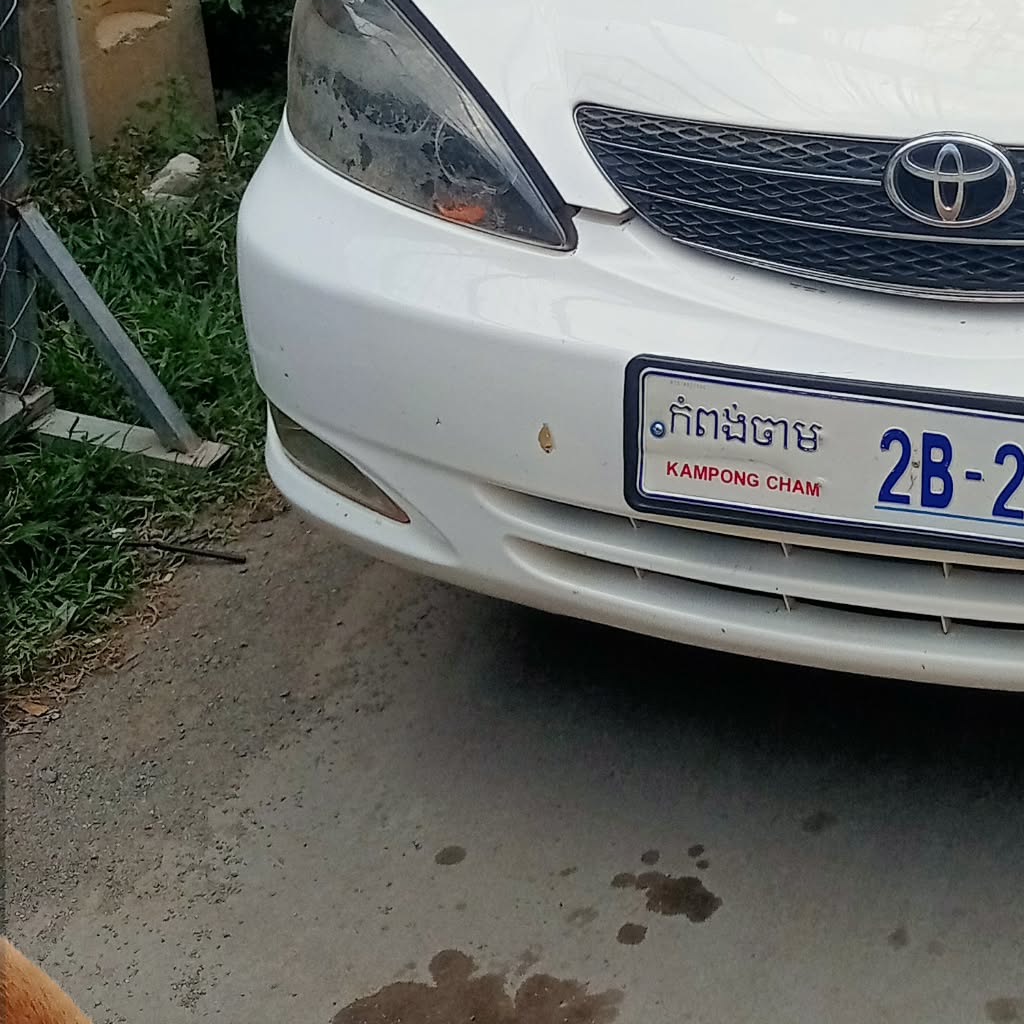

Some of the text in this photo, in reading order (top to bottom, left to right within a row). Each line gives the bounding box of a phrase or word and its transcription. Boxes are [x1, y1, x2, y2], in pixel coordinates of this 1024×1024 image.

[669, 395, 823, 453] កំពង់ចាម
[666, 461, 821, 497] KAMPONG CHAM
